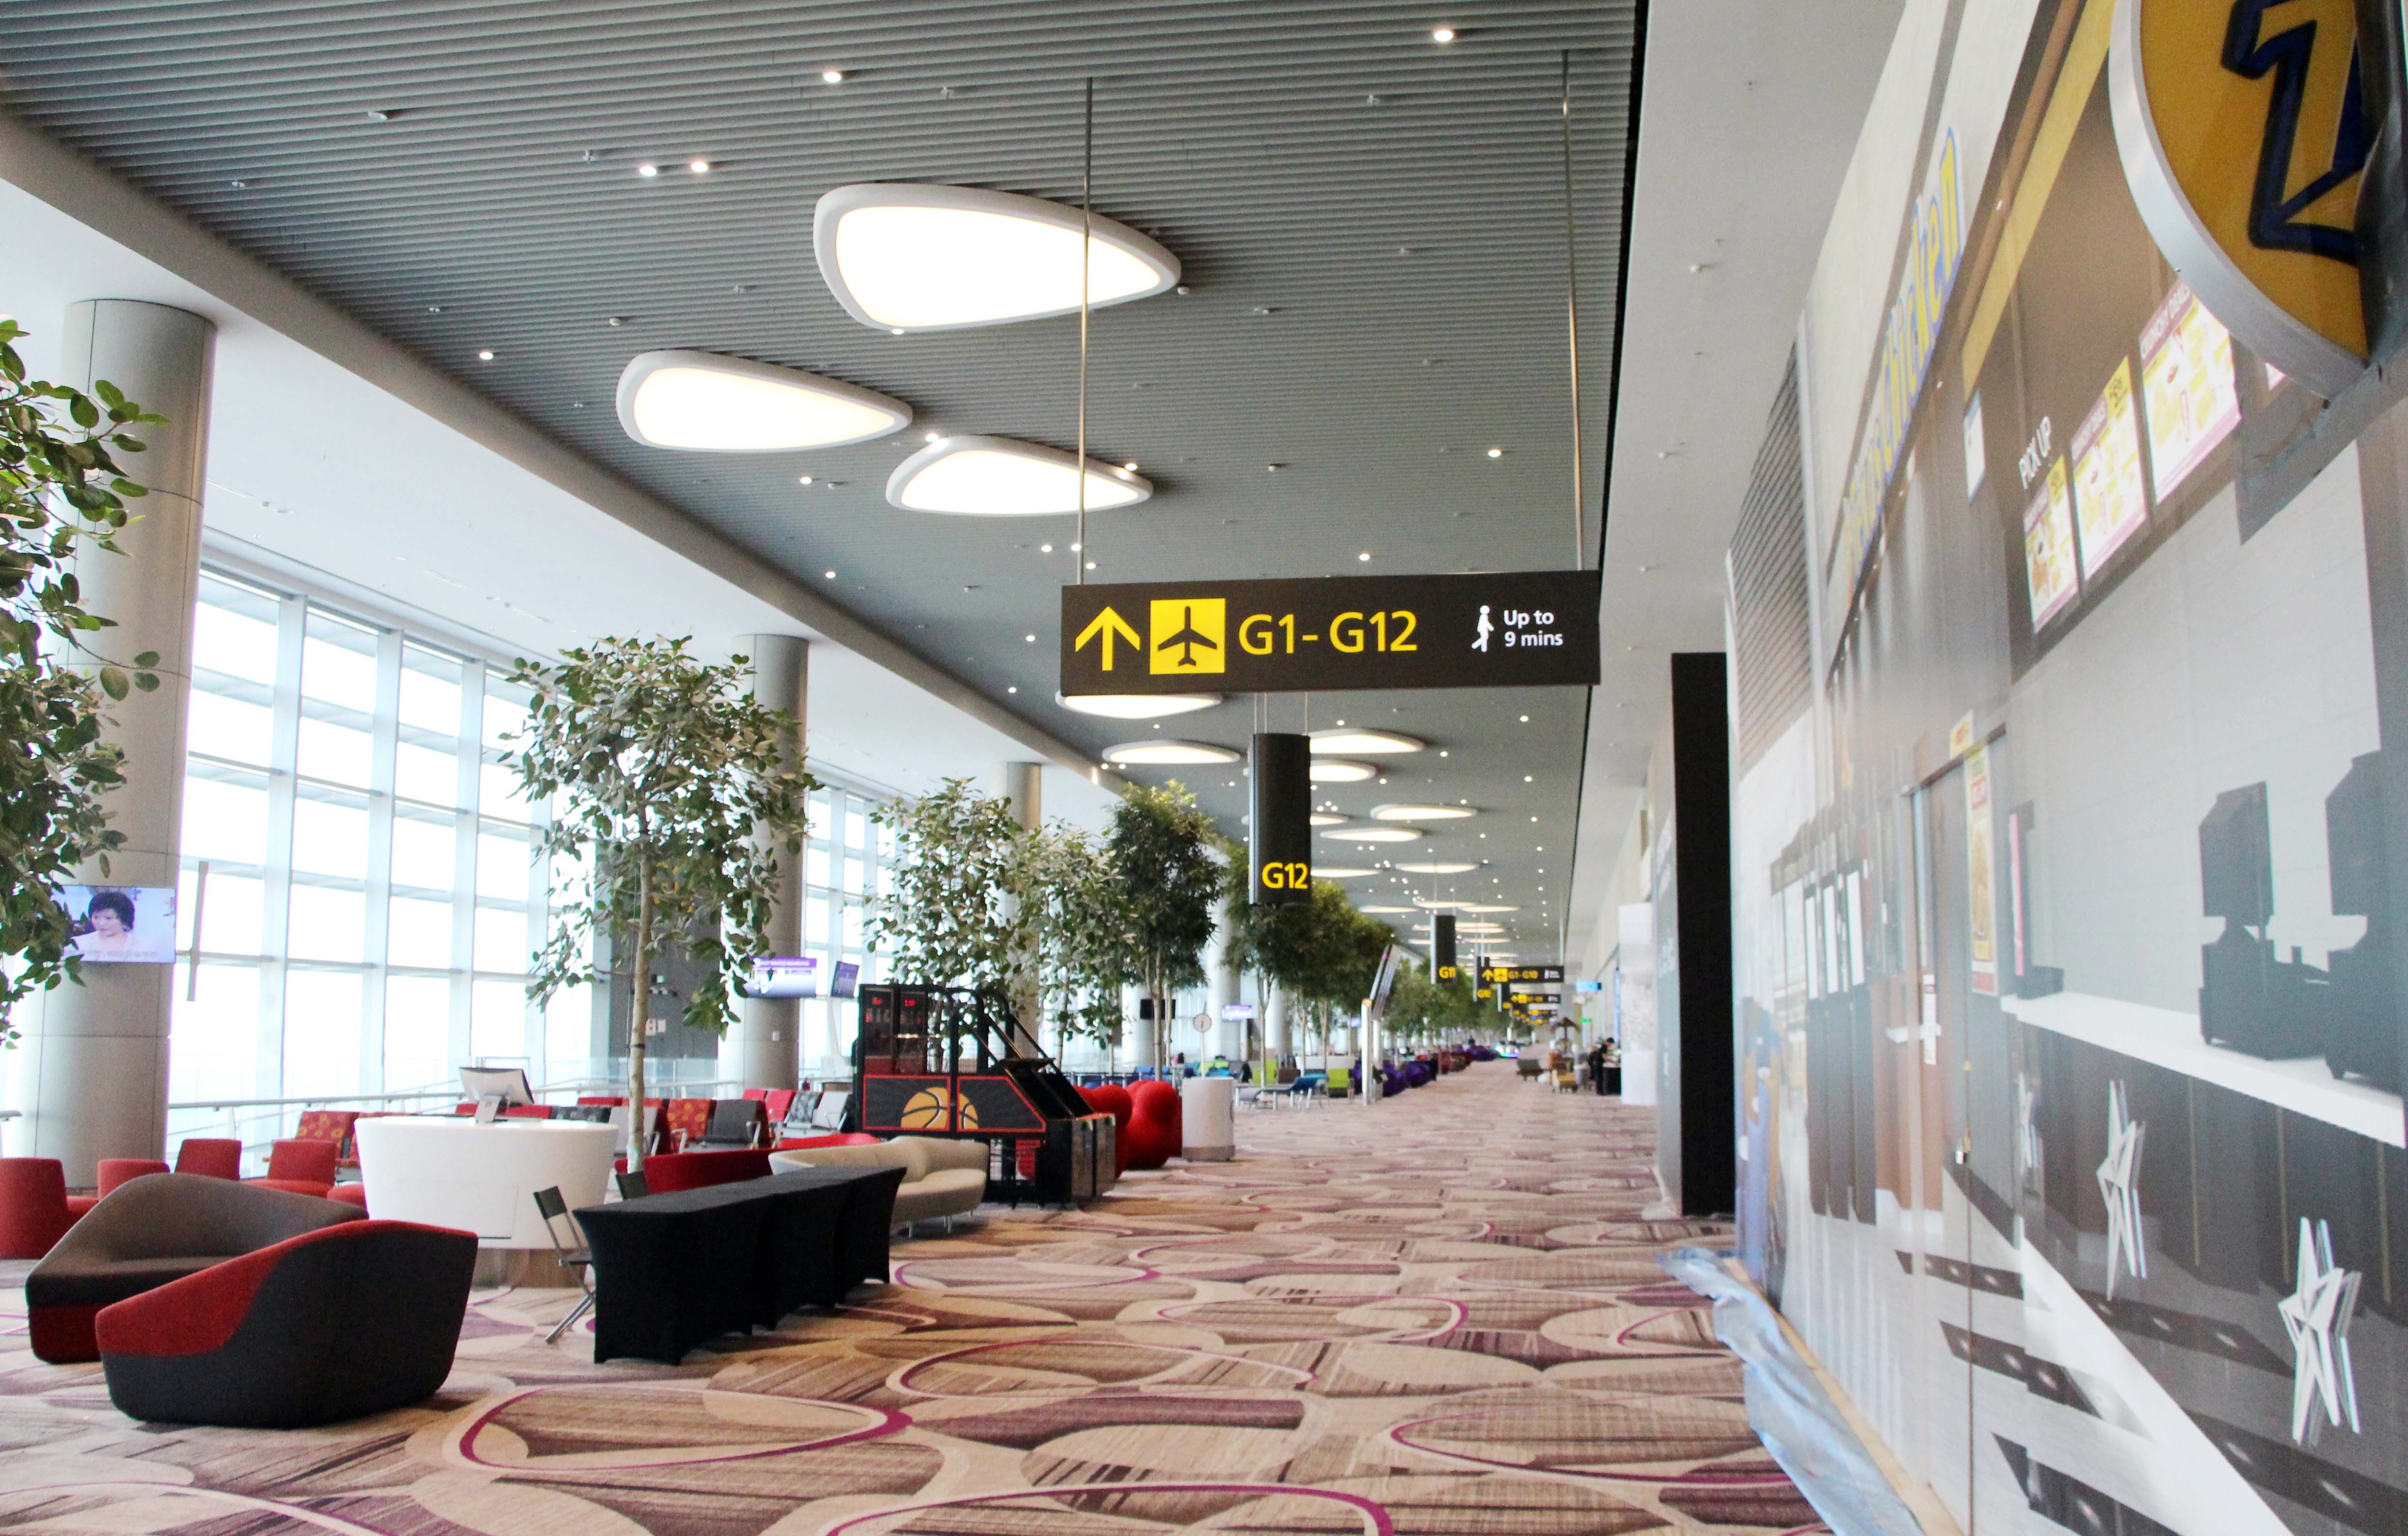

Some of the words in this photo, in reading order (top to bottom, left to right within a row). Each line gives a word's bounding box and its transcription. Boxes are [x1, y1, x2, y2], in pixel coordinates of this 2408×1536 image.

[2018, 436, 2042, 490] PICK
[2035, 416, 2052, 457] UP
[1503, 609, 1530, 629] Up
[1533, 609, 1555, 625] to
[1329, 610, 1418, 653] G12
[1504, 631, 1515, 647] 9
[1520, 630, 1564, 647] mins
[1261, 861, 1309, 890] G12
[1439, 966, 1456, 979] G11
